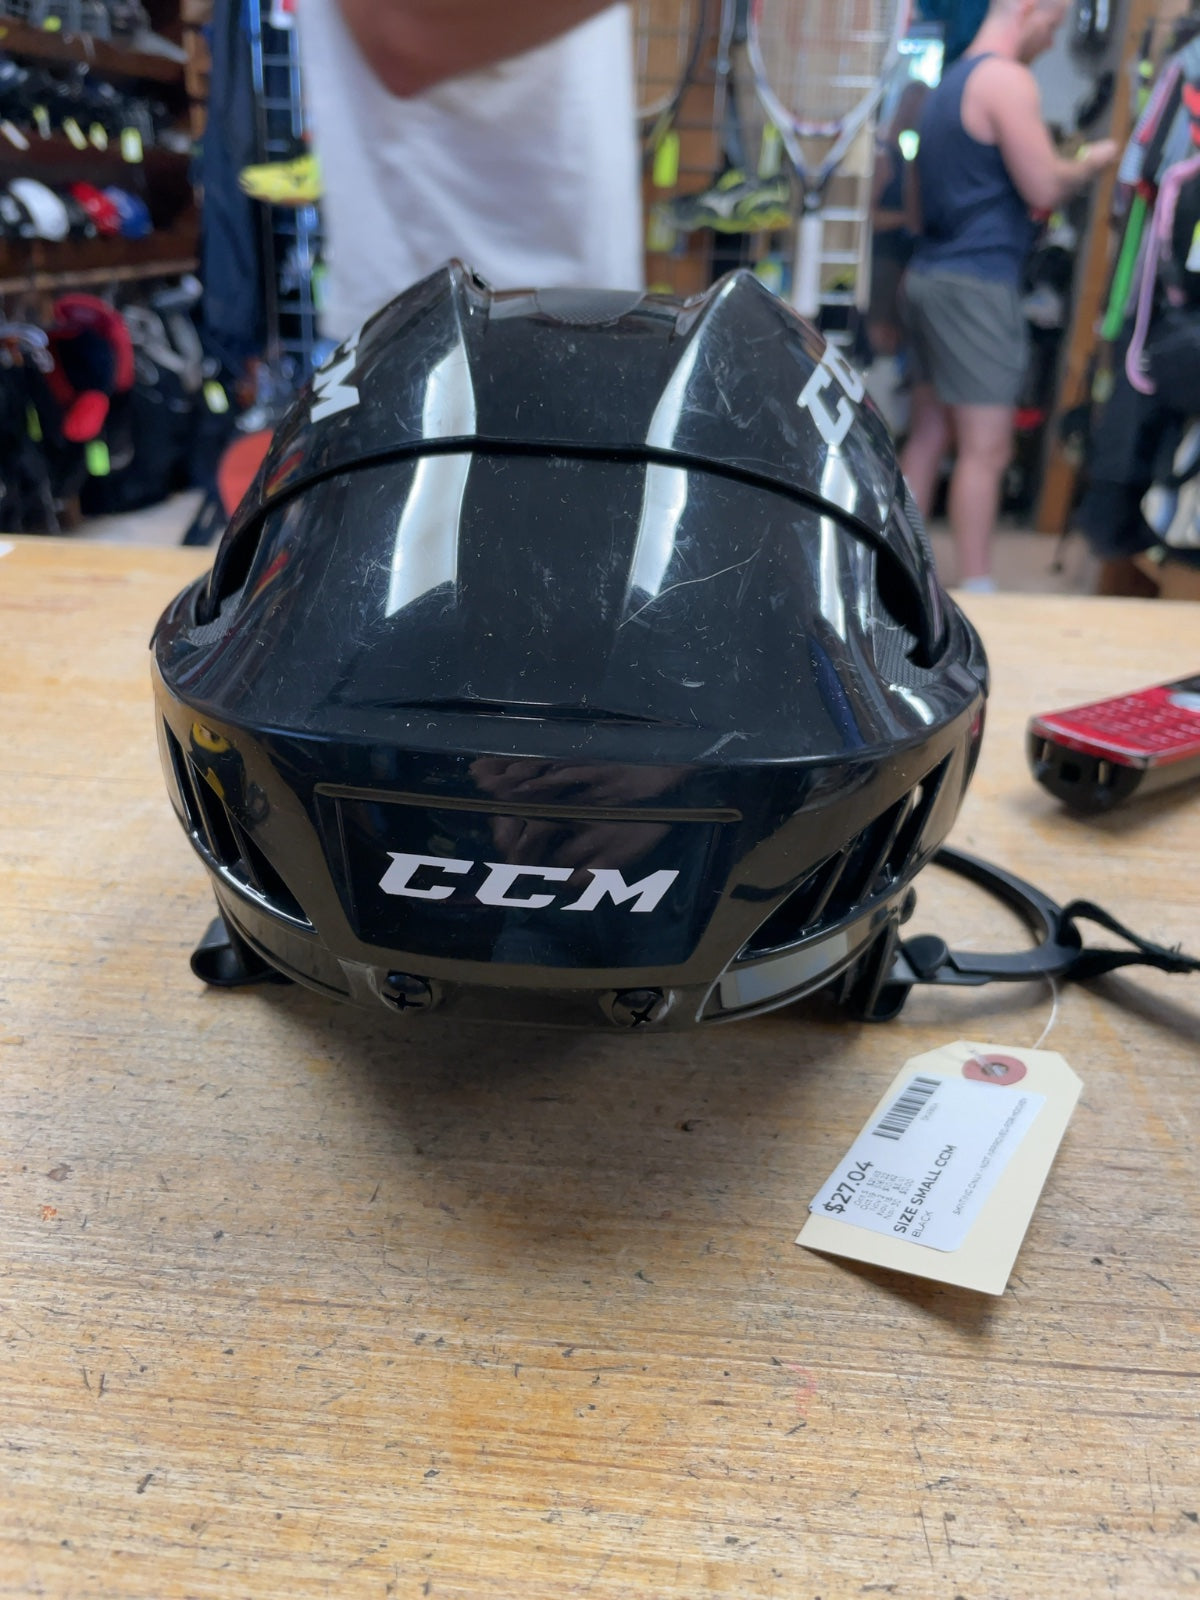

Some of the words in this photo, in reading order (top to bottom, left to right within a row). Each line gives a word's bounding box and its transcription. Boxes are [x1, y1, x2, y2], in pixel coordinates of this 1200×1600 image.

[378, 851, 680, 912] CCM
[824, 1160, 874, 1214] $27.04
[893, 1205, 919, 1233] SIZE
[911, 1170, 941, 1206] SMALL
[934, 1144, 957, 1168] CCM
[911, 1210, 933, 1238] BLACK
